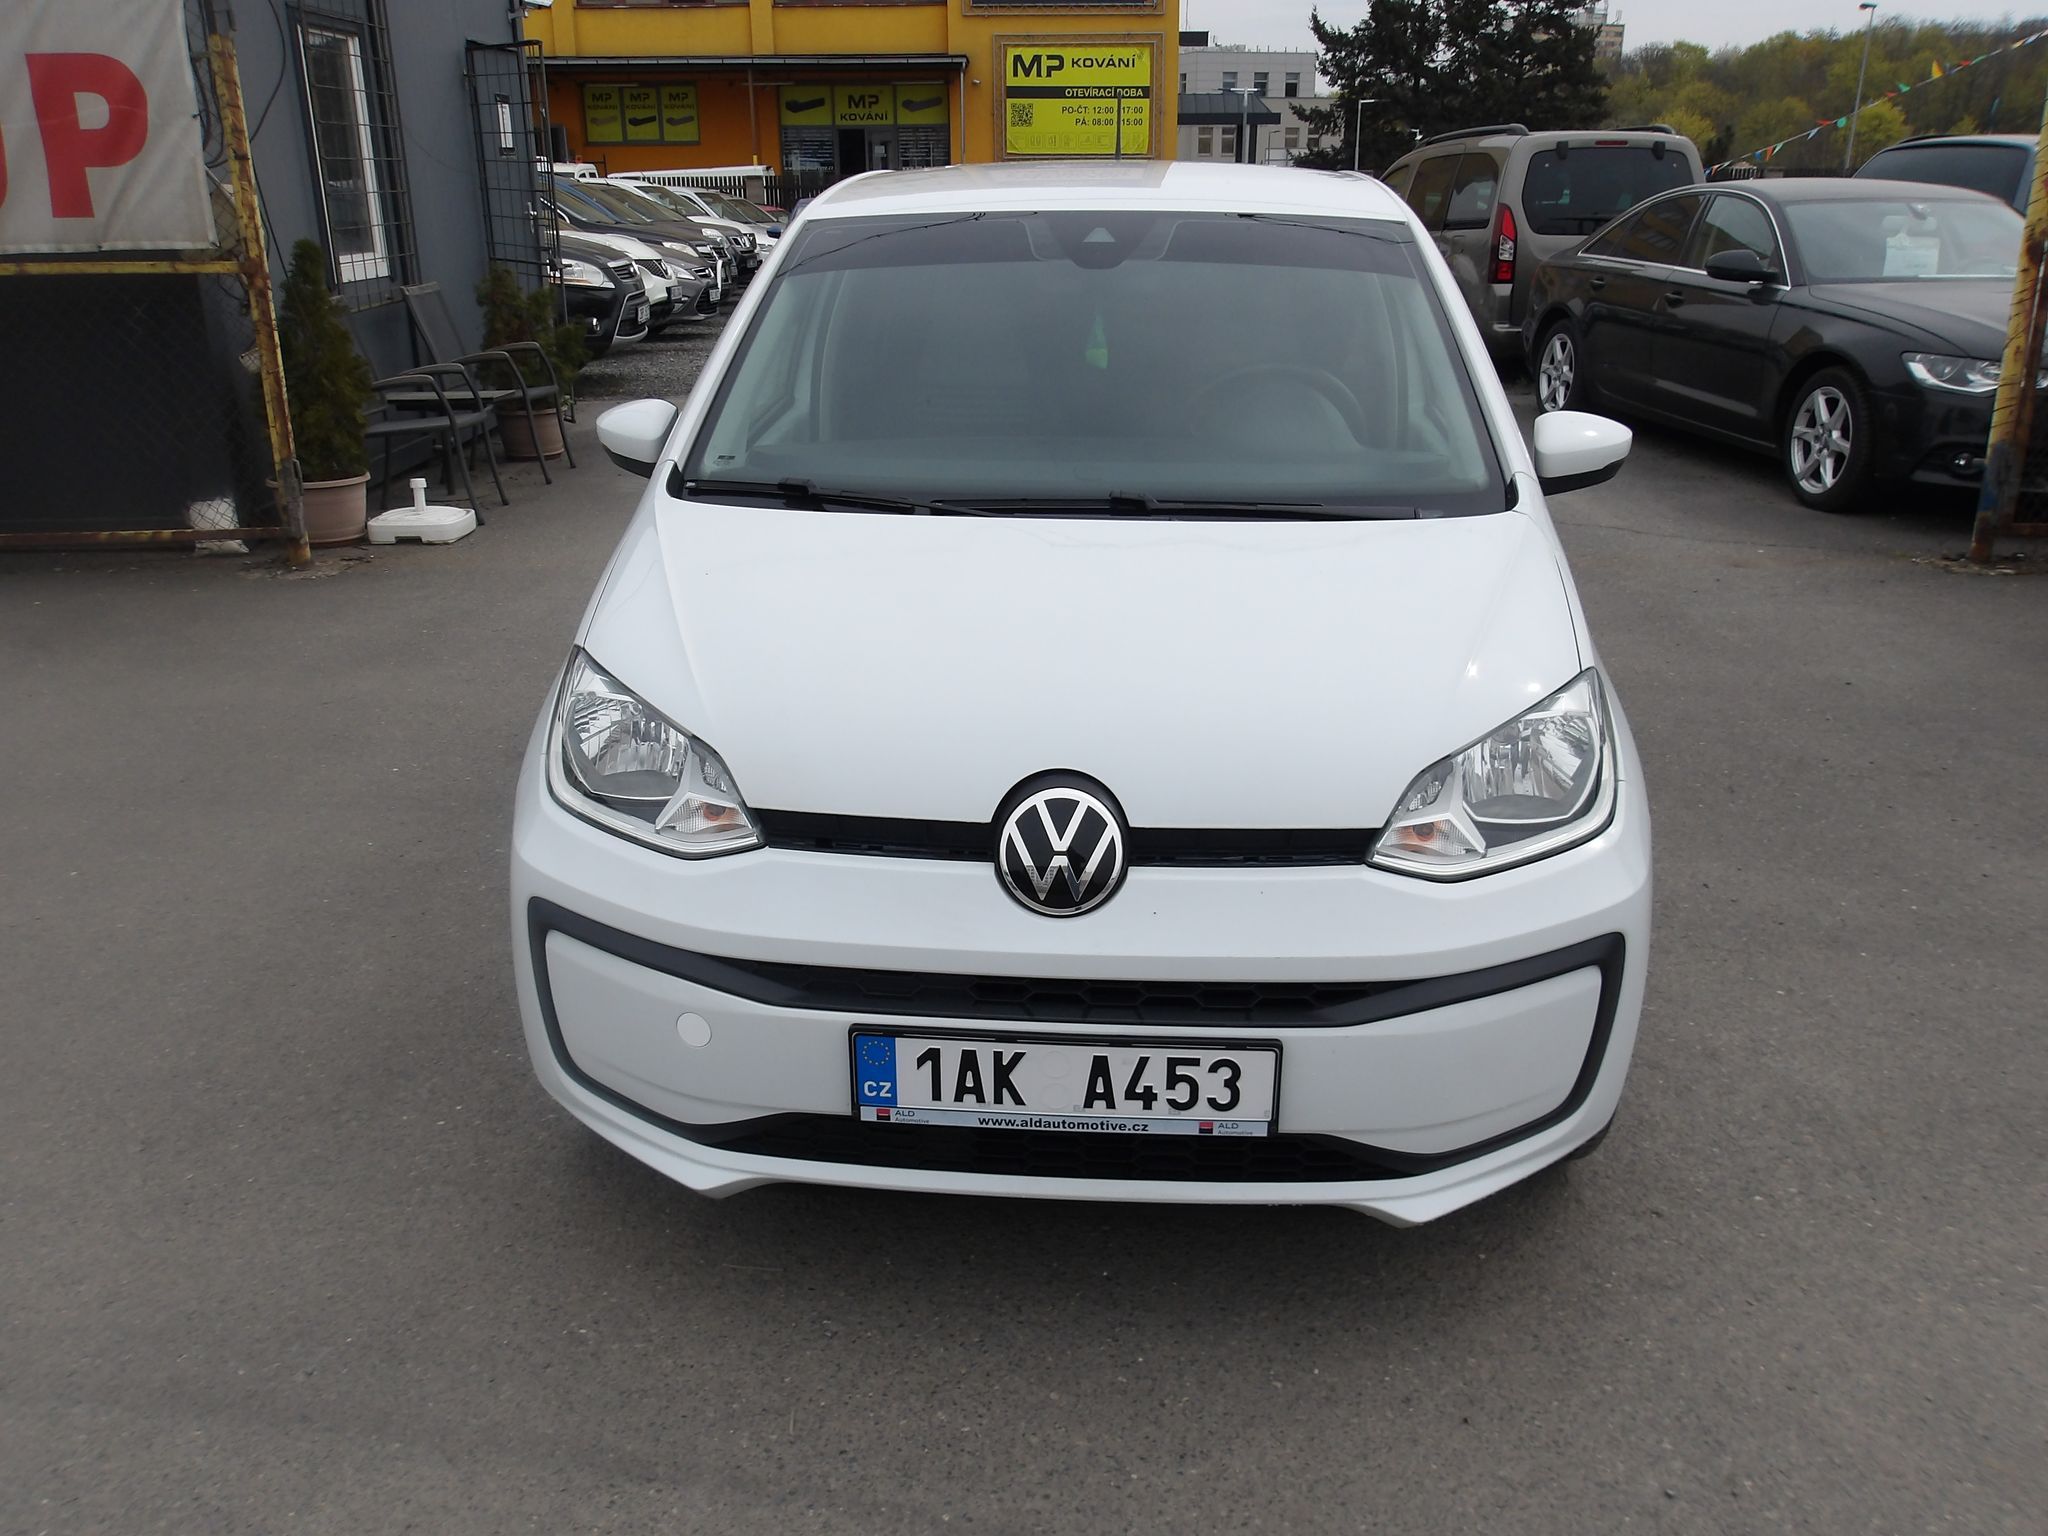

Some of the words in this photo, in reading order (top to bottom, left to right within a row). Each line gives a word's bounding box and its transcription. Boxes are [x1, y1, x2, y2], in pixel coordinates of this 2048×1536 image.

[1012, 54, 1065, 78] MP
[1071, 54, 1136, 68] KOVÁNÍ
[1065, 86, 1115, 97] OTEVÍRACÍ
[592, 93, 612, 102] MP
[630, 93, 650, 102] MP
[668, 93, 689, 102] MP
[848, 95, 880, 109] MP
[1061, 105, 1090, 114] PO-ČT:
[1093, 106, 1114, 114] 12:00
[1122, 106, 1143, 114] 17:00
[840, 110, 888, 121] KOVÁNÍ
[1075, 116, 1090, 126] PÁ:
[1092, 118, 1114, 126] 08:00
[1121, 118, 1143, 126] 15:00
[0, 53, 148, 218] P
[916, 1047, 1027, 1106] 1AK
[1083, 1055, 1242, 1112] A453
[863, 1080, 892, 1098] CZ
[977, 1116, 1149, 1132] www.aldautomotive.cz
